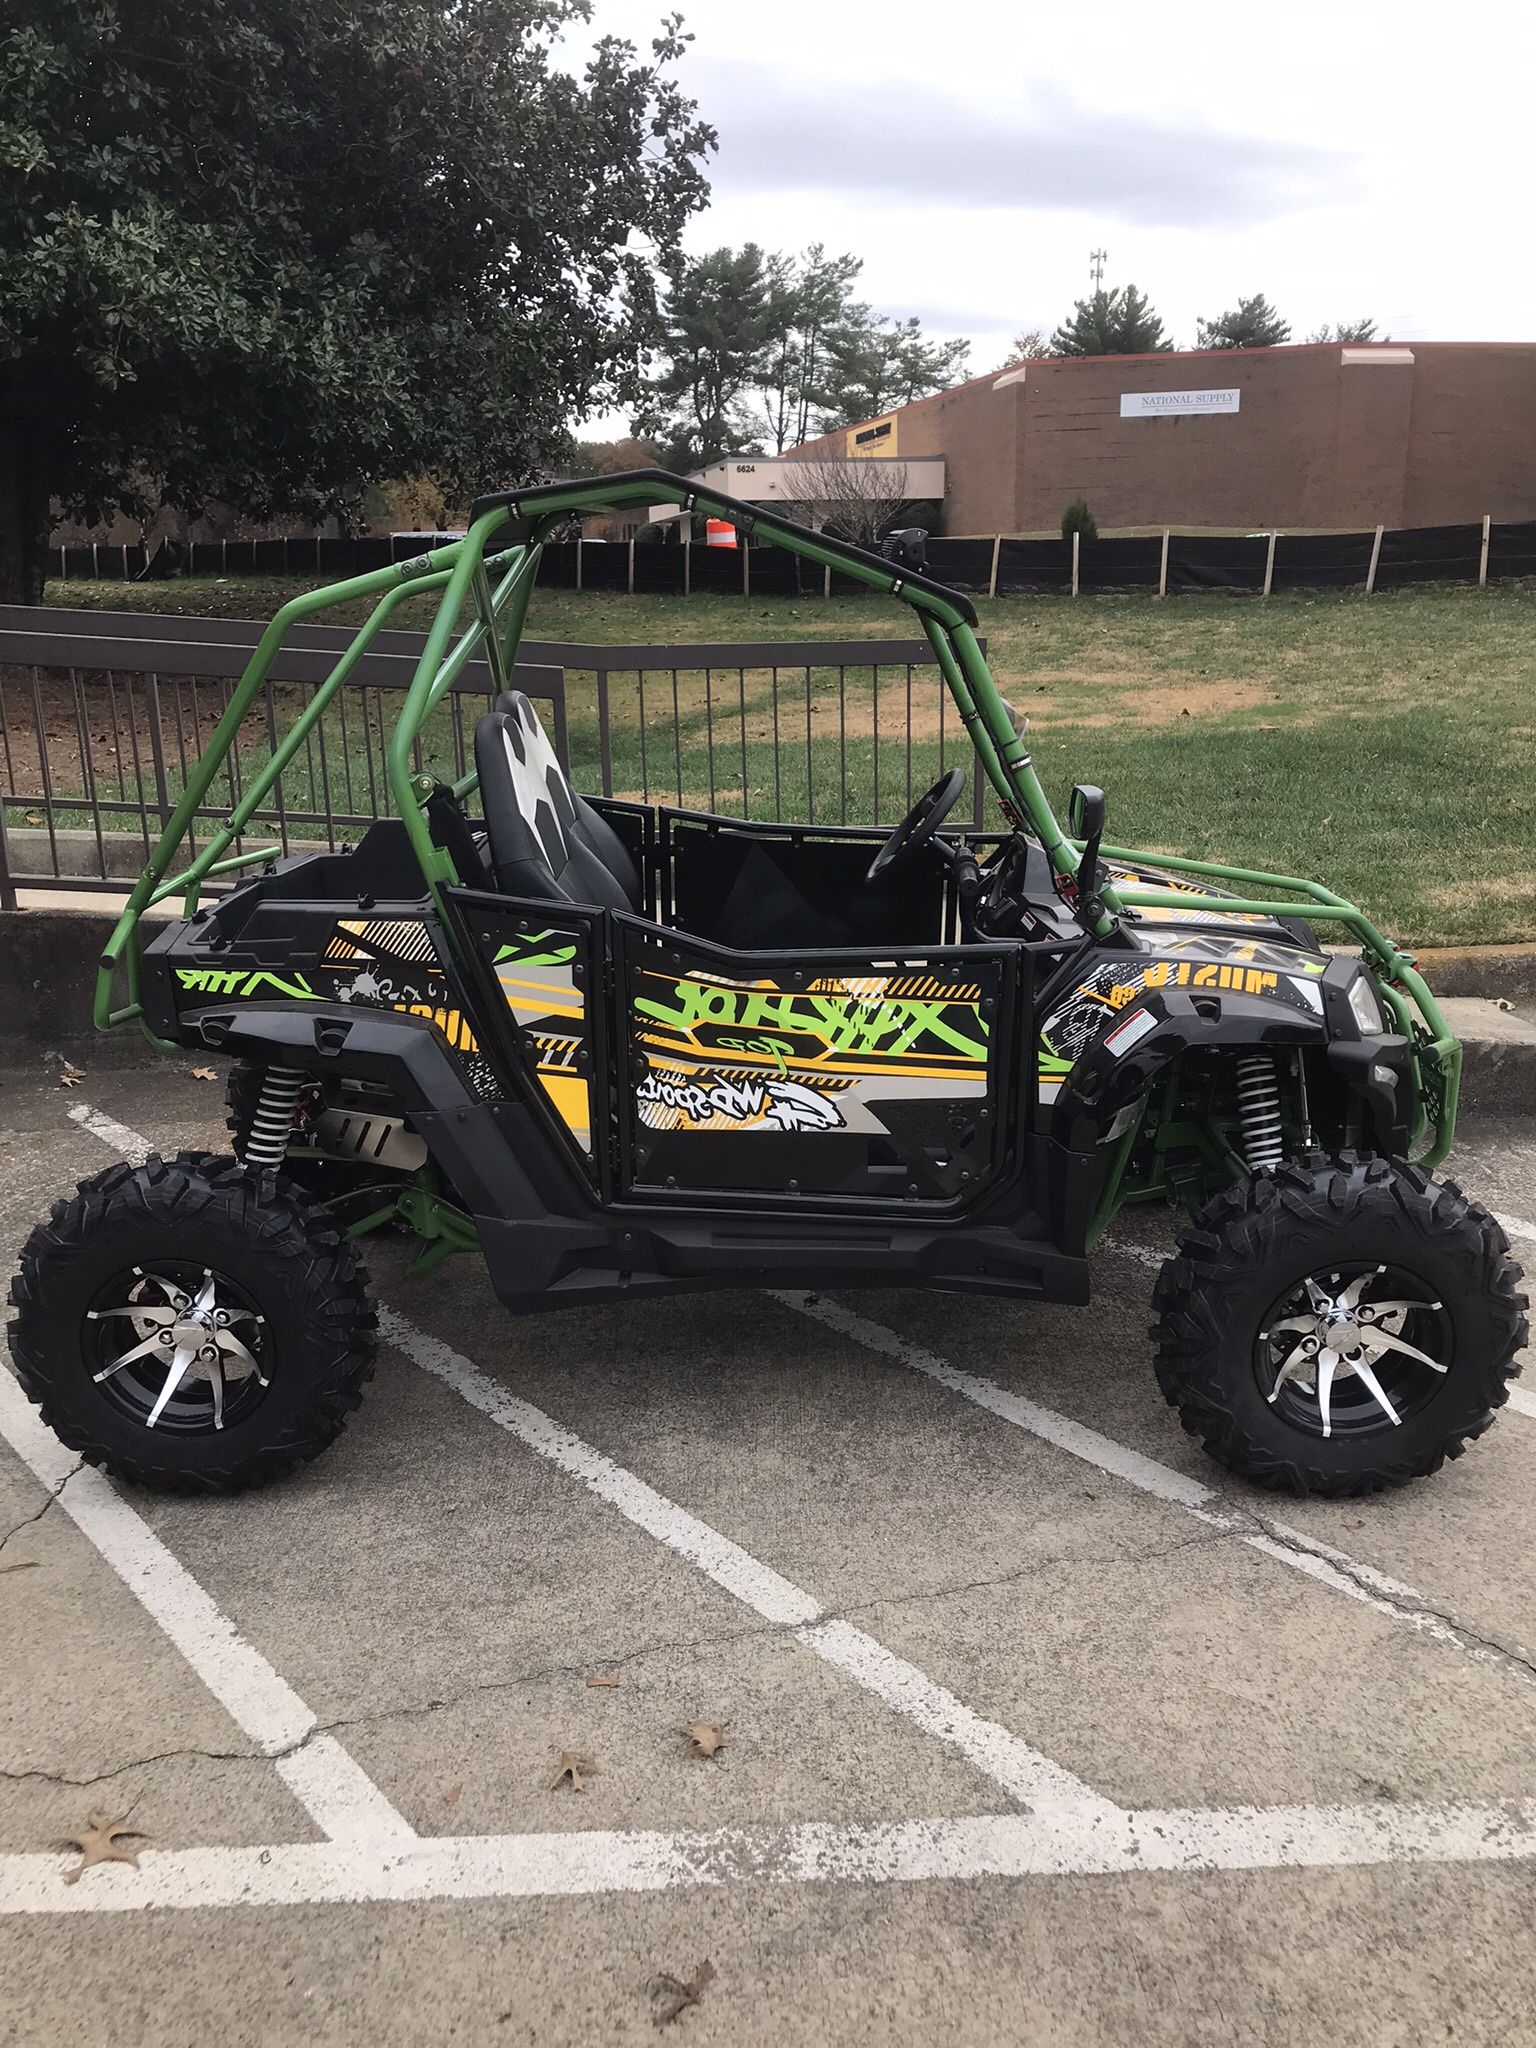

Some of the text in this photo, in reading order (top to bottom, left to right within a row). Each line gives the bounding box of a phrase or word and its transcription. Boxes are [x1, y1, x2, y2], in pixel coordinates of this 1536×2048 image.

[1142, 393, 1234, 405] NATIONAL SUPPLY
[736, 464, 756, 473] 6624
